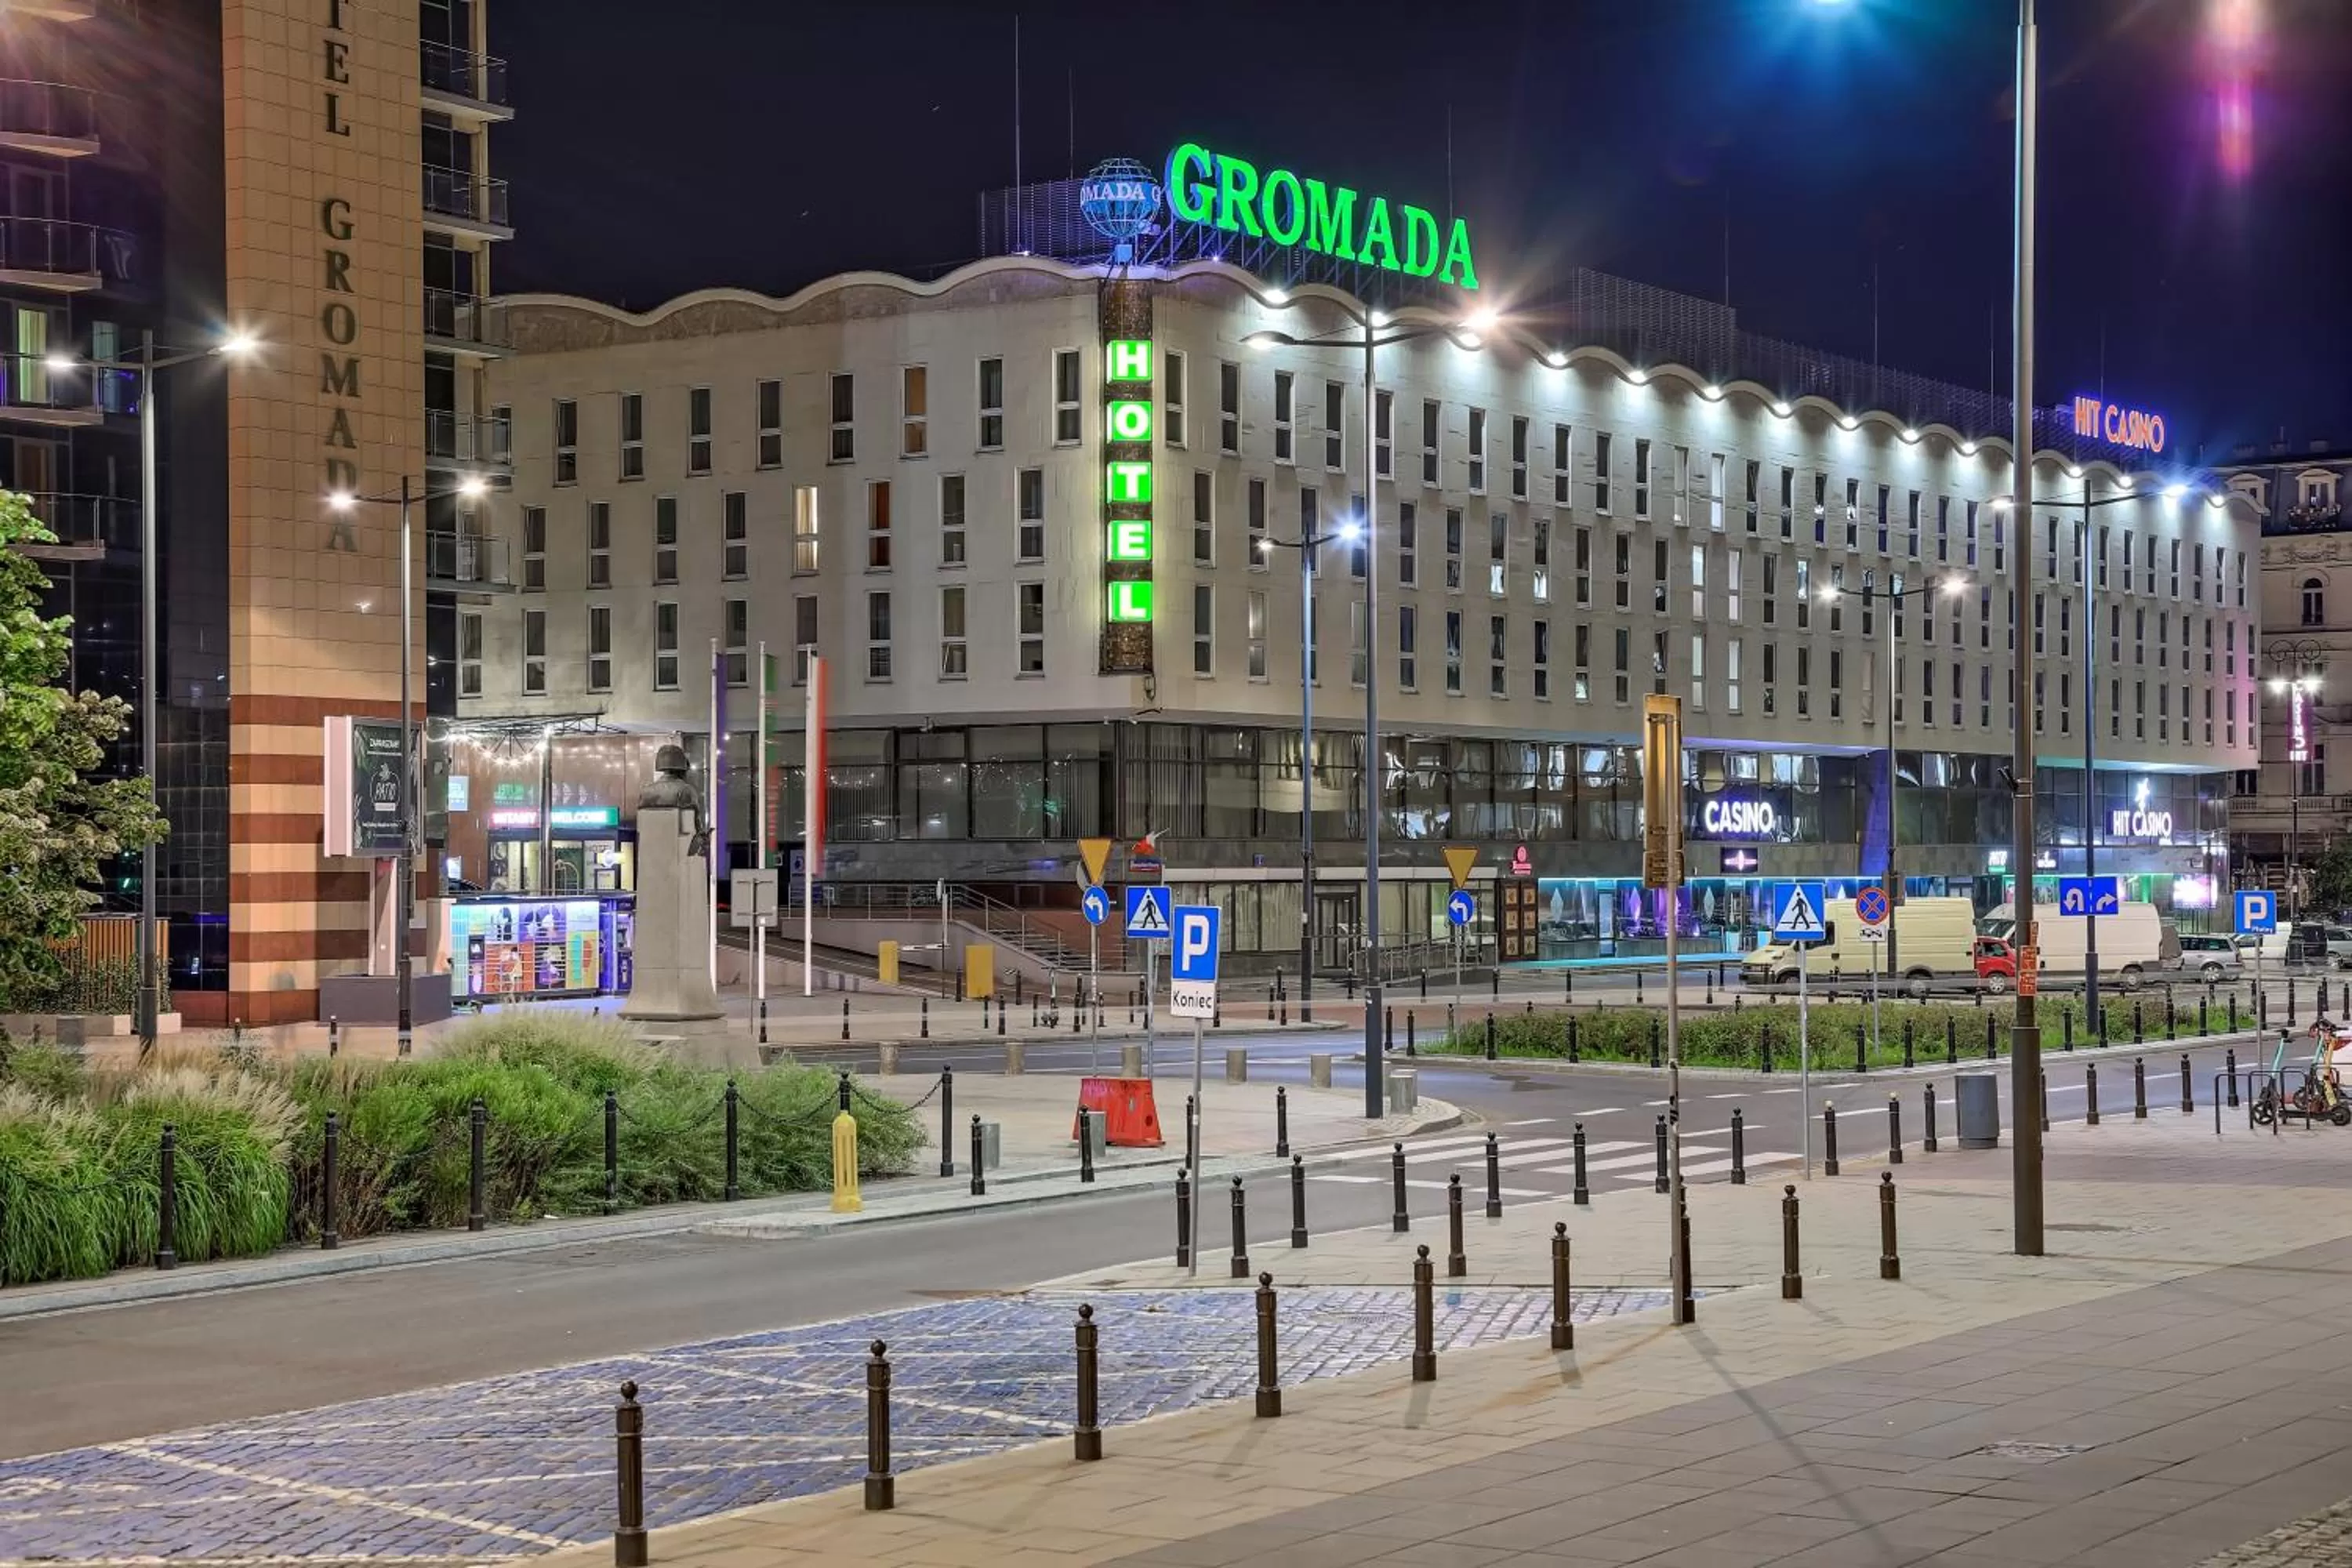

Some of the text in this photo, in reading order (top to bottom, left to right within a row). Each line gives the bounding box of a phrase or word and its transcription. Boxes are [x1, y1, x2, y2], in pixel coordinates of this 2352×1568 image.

[1171, 143, 1479, 289] GROMADA
[2074, 397, 2165, 452] HIT CASINO
[1116, 343, 1148, 618] HOTEL
[1705, 800, 1773, 833] CASINO
[2113, 810, 2172, 837] HIT CASINO
[2244, 896, 2267, 929] P
[1181, 915, 1210, 971] P
[1172, 990, 1213, 1009] Koniec
